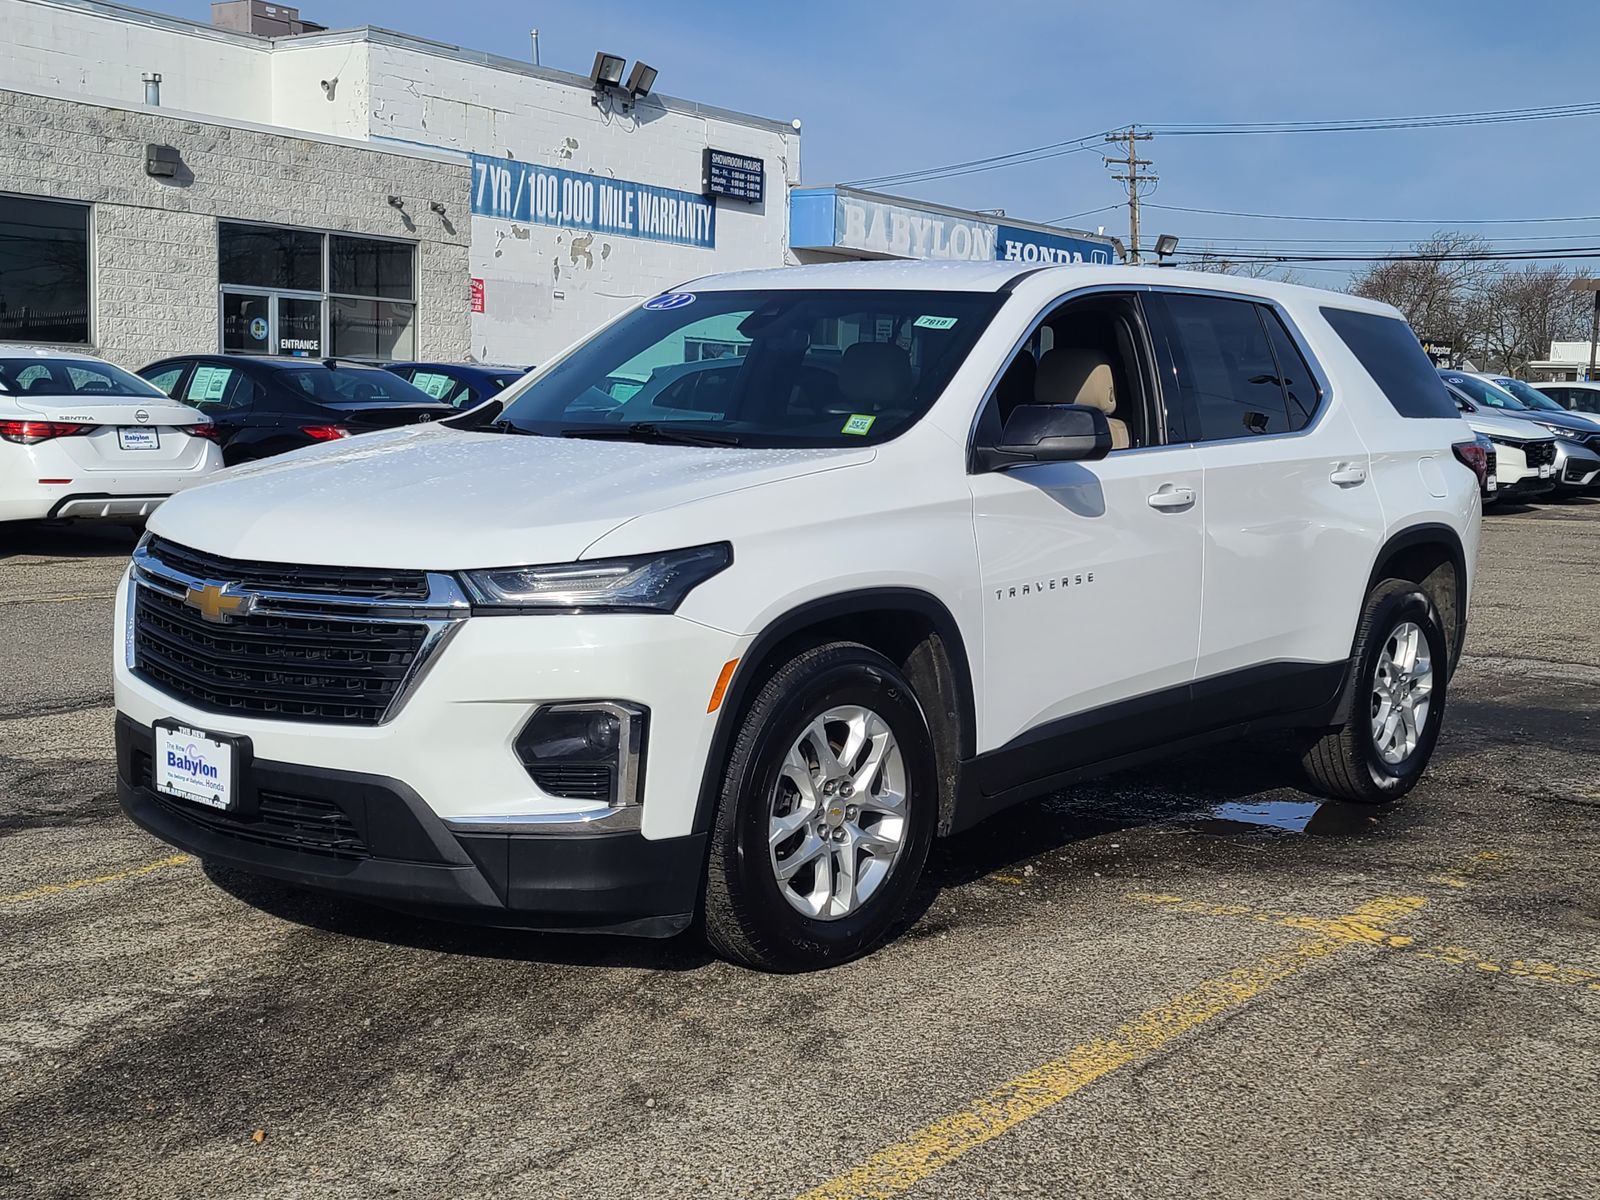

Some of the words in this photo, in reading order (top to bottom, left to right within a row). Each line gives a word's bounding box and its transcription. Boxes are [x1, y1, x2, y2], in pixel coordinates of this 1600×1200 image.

[712, 153, 742, 168] SHOWROOM
[743, 160, 760, 172] HOURS
[475, 163, 487, 207] 7
[490, 166, 511, 212] YR
[528, 172, 594, 226] 100,000
[599, 184, 633, 230] MILE
[637, 191, 712, 241] WARRANTY
[843, 204, 992, 261] BABYLON
[1004, 240, 1083, 264] HONDA
[281, 338, 318, 350] ENTRANCE
[1429, 344, 1452, 356] flagstar
[995, 572, 1094, 600] TRAVERSE
[176, 744, 184, 752] New
[167, 751, 217, 778] Babylon
[206, 779, 224, 792] Honda
